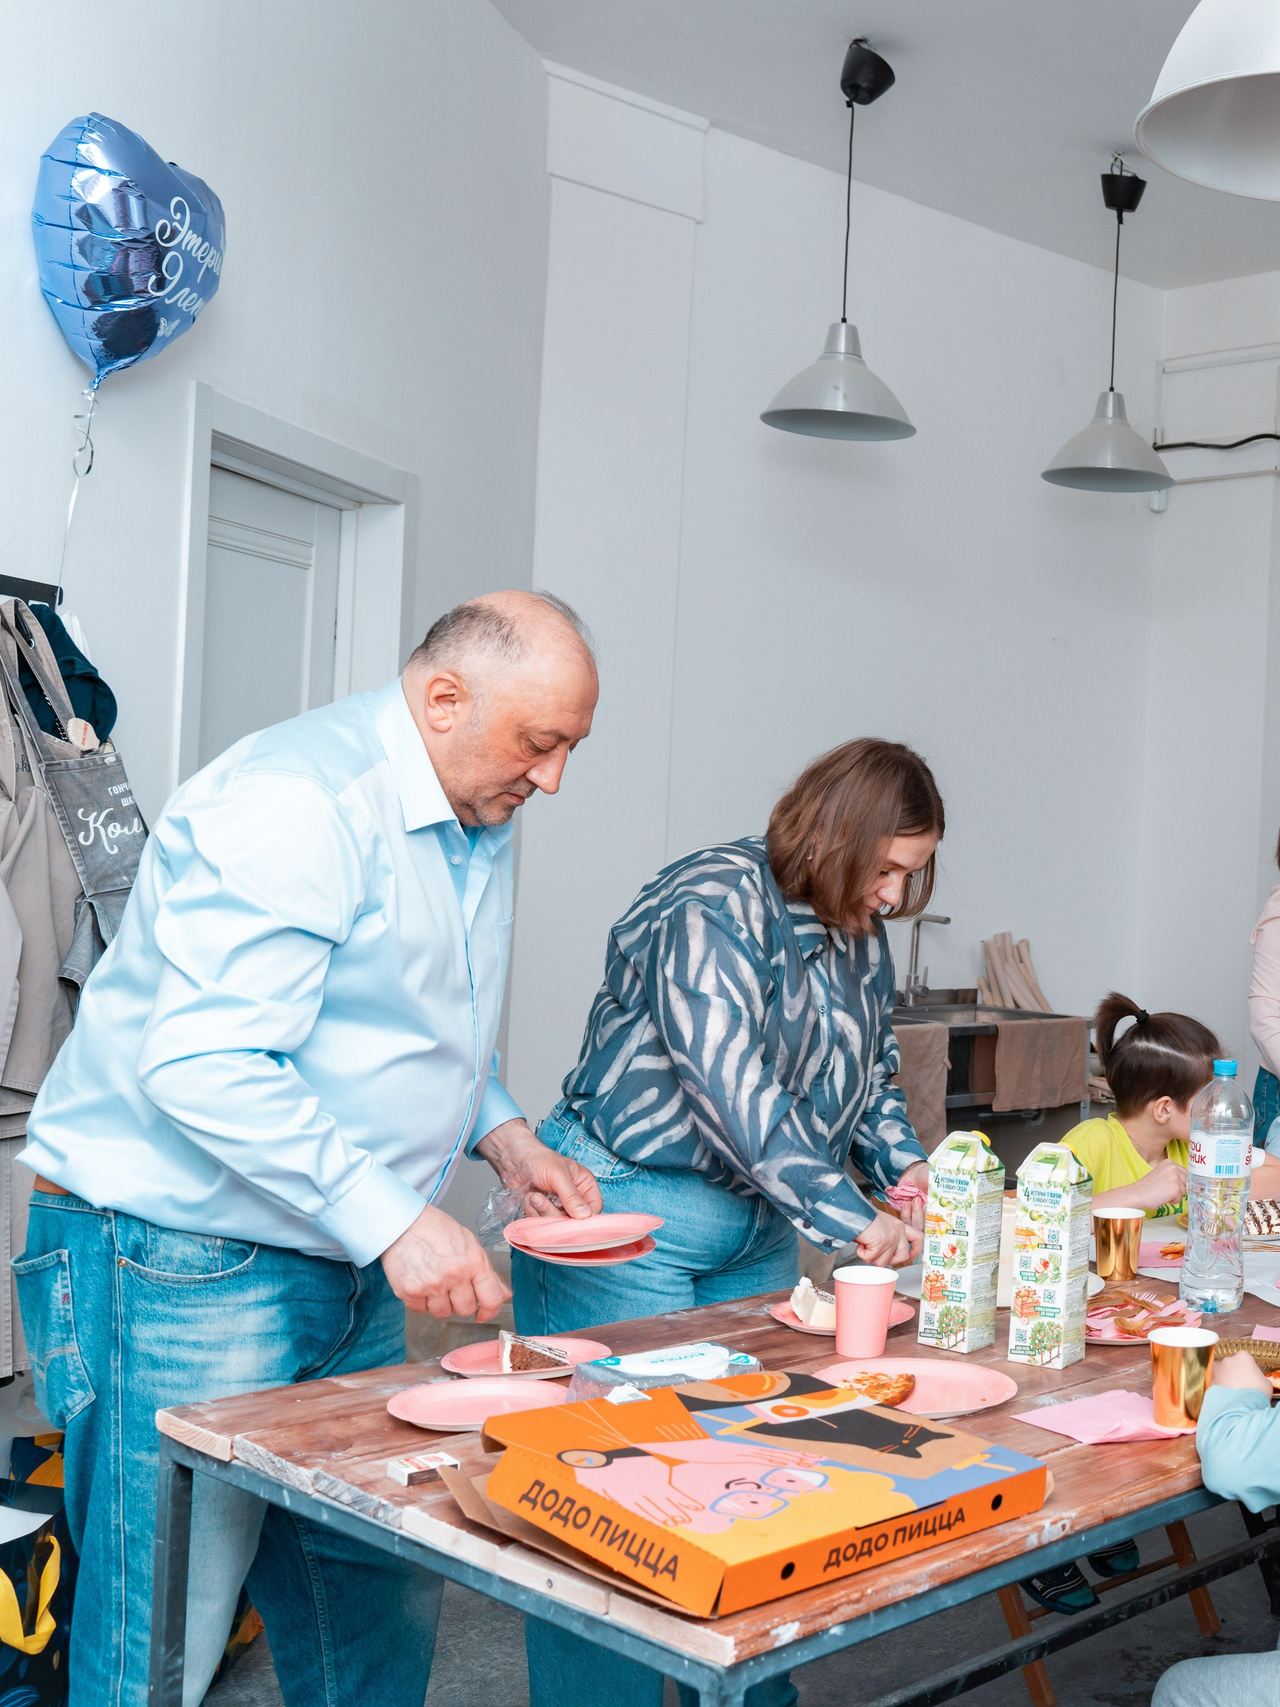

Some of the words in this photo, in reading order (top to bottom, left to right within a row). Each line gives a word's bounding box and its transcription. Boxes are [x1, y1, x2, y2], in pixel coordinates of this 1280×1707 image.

[107, 782, 130, 797] ГОНЧ
[77, 807, 144, 855] Кол
[518, 1479, 592, 1530] ДОДО
[590, 1514, 679, 1582] ПИЦЦА
[823, 1533, 889, 1572] ДОДО
[893, 1507, 966, 1546] ПИЦЦА
